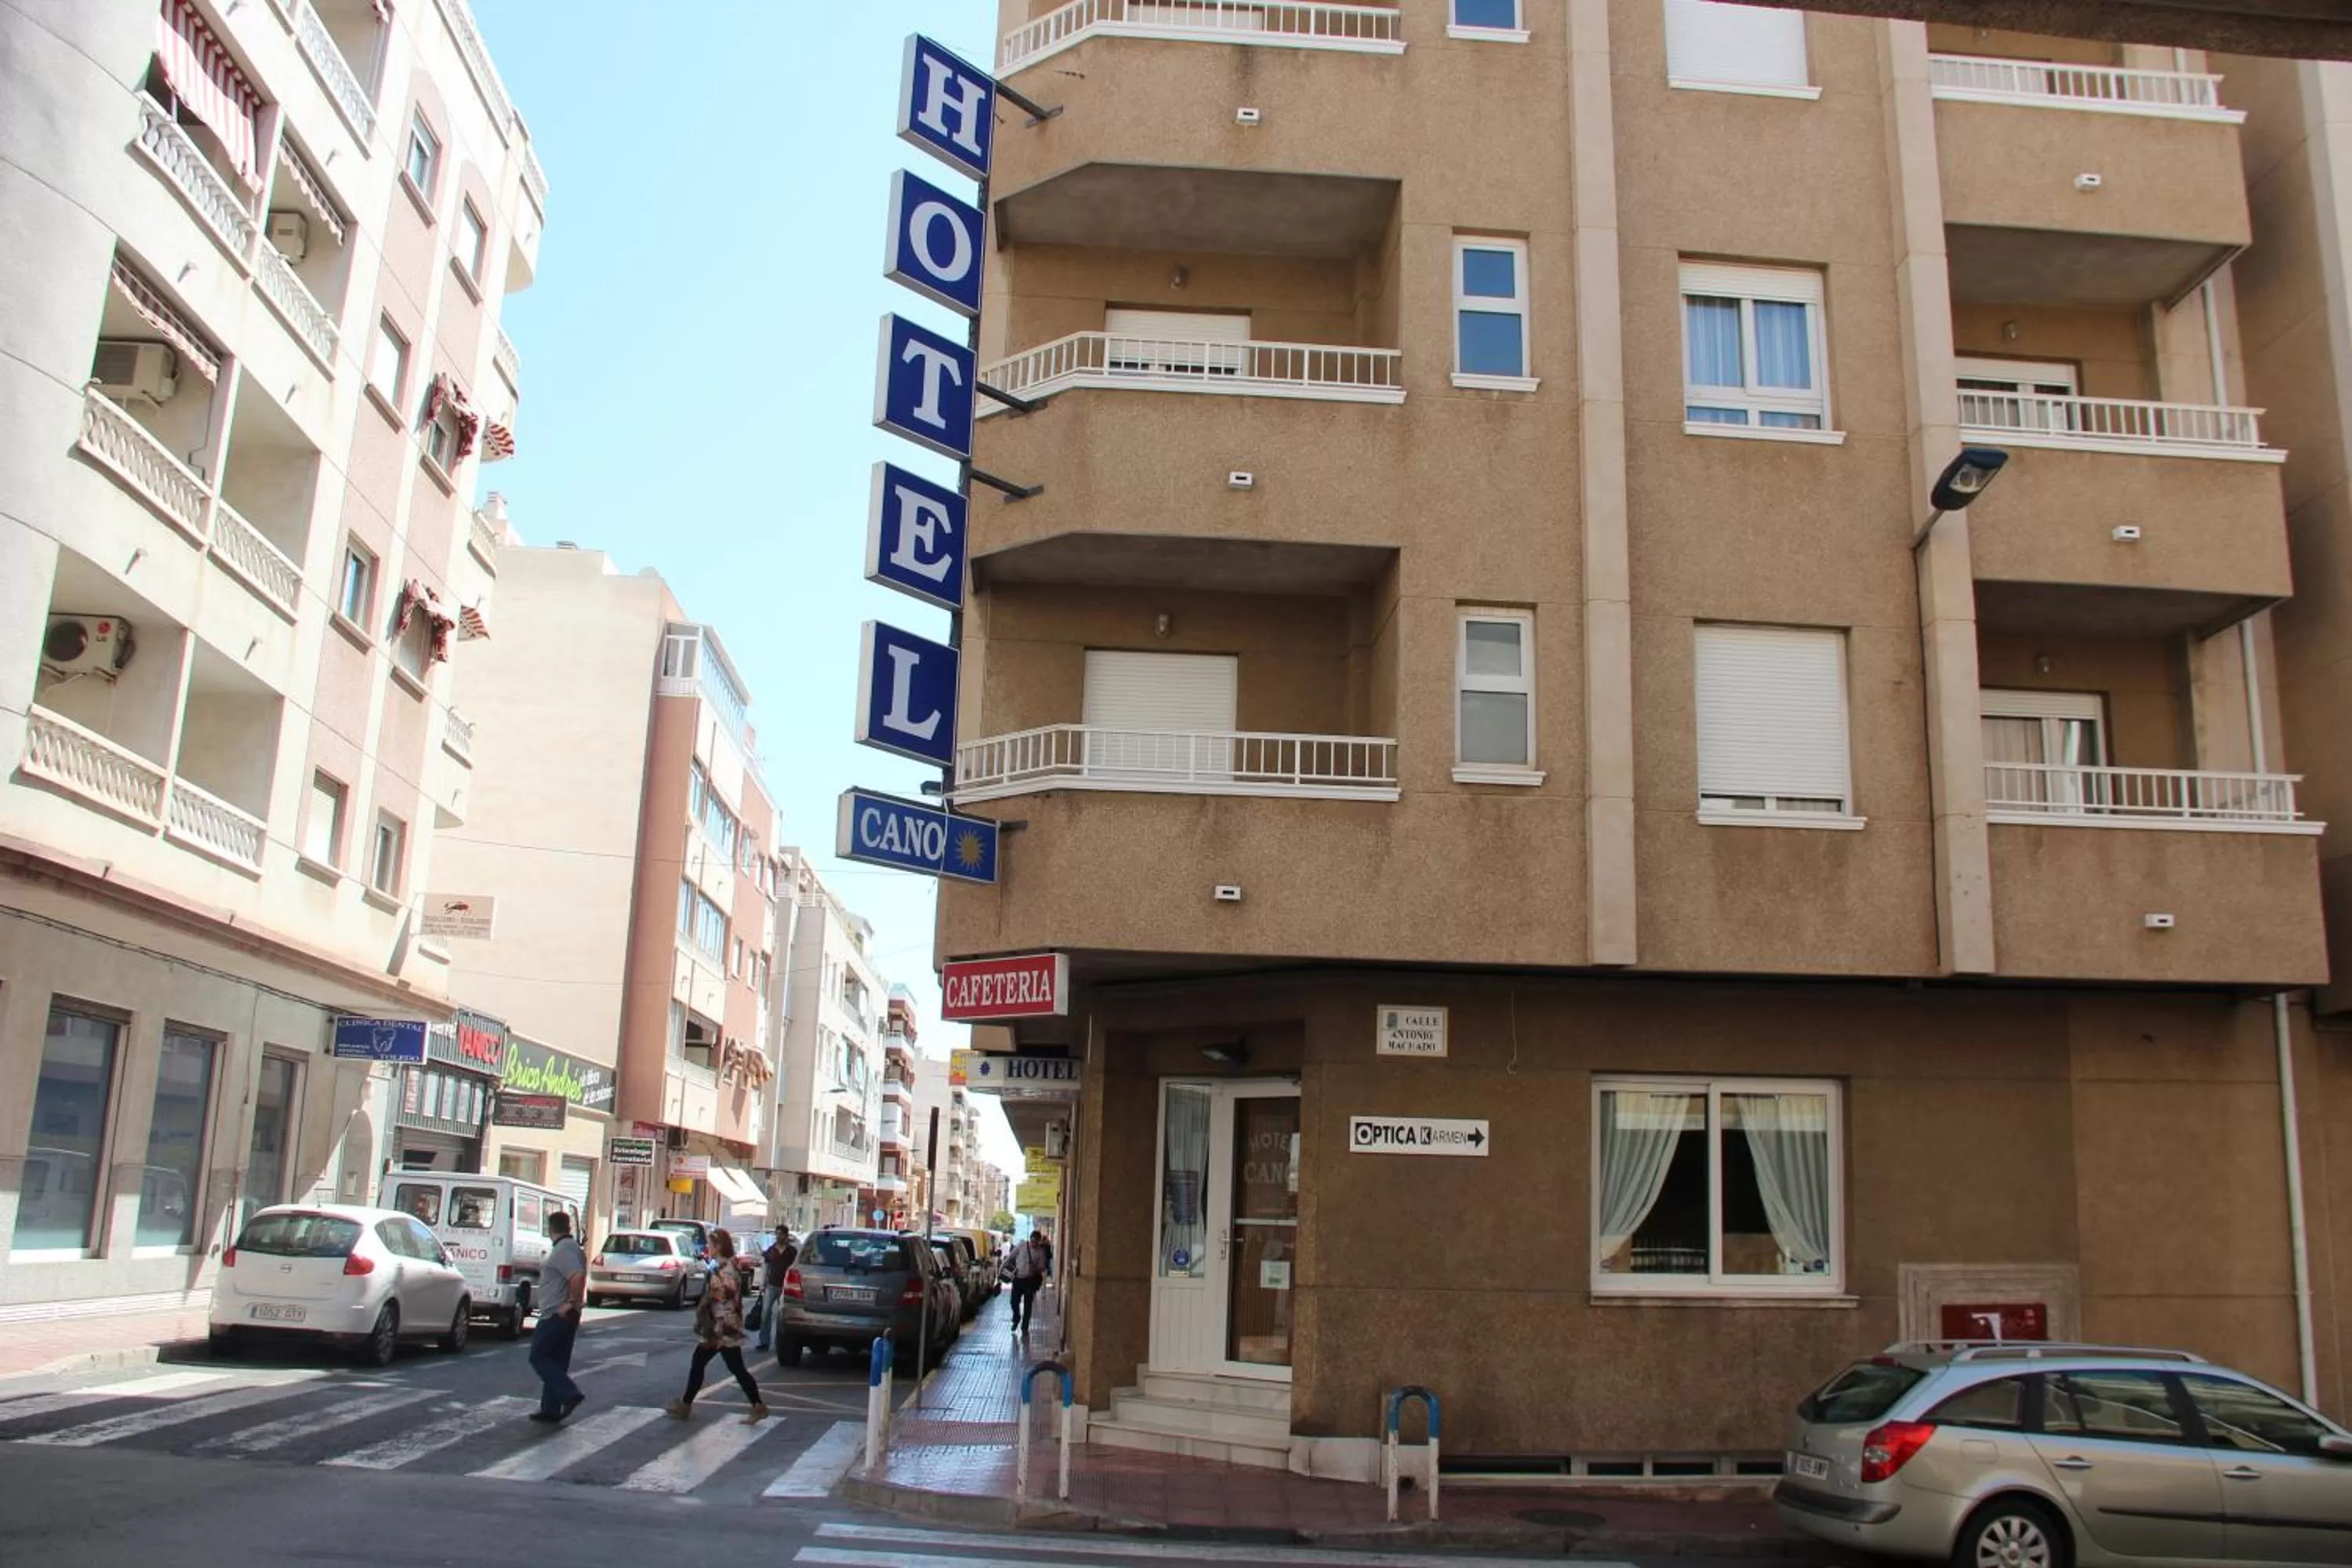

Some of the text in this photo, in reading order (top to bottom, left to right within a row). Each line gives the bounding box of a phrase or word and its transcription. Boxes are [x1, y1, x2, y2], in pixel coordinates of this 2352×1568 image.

[883, 52, 986, 742] HOTEL
[861, 805, 944, 862] CANO
[946, 969, 1052, 1007] CAFETERIA
[1406, 1016, 1440, 1026] CALLE
[1391, 1030, 1434, 1040] ANTONIO
[1388, 1041, 1436, 1051] MACHADO
[503, 1043, 540, 1091] Brico
[1007, 1059, 1078, 1080] HOTEL
[1248, 1132, 1290, 1153] HOTE
[1354, 1122, 1467, 1145] OPTICA KARMEN
[441, 1247, 488, 1259] ANICO
